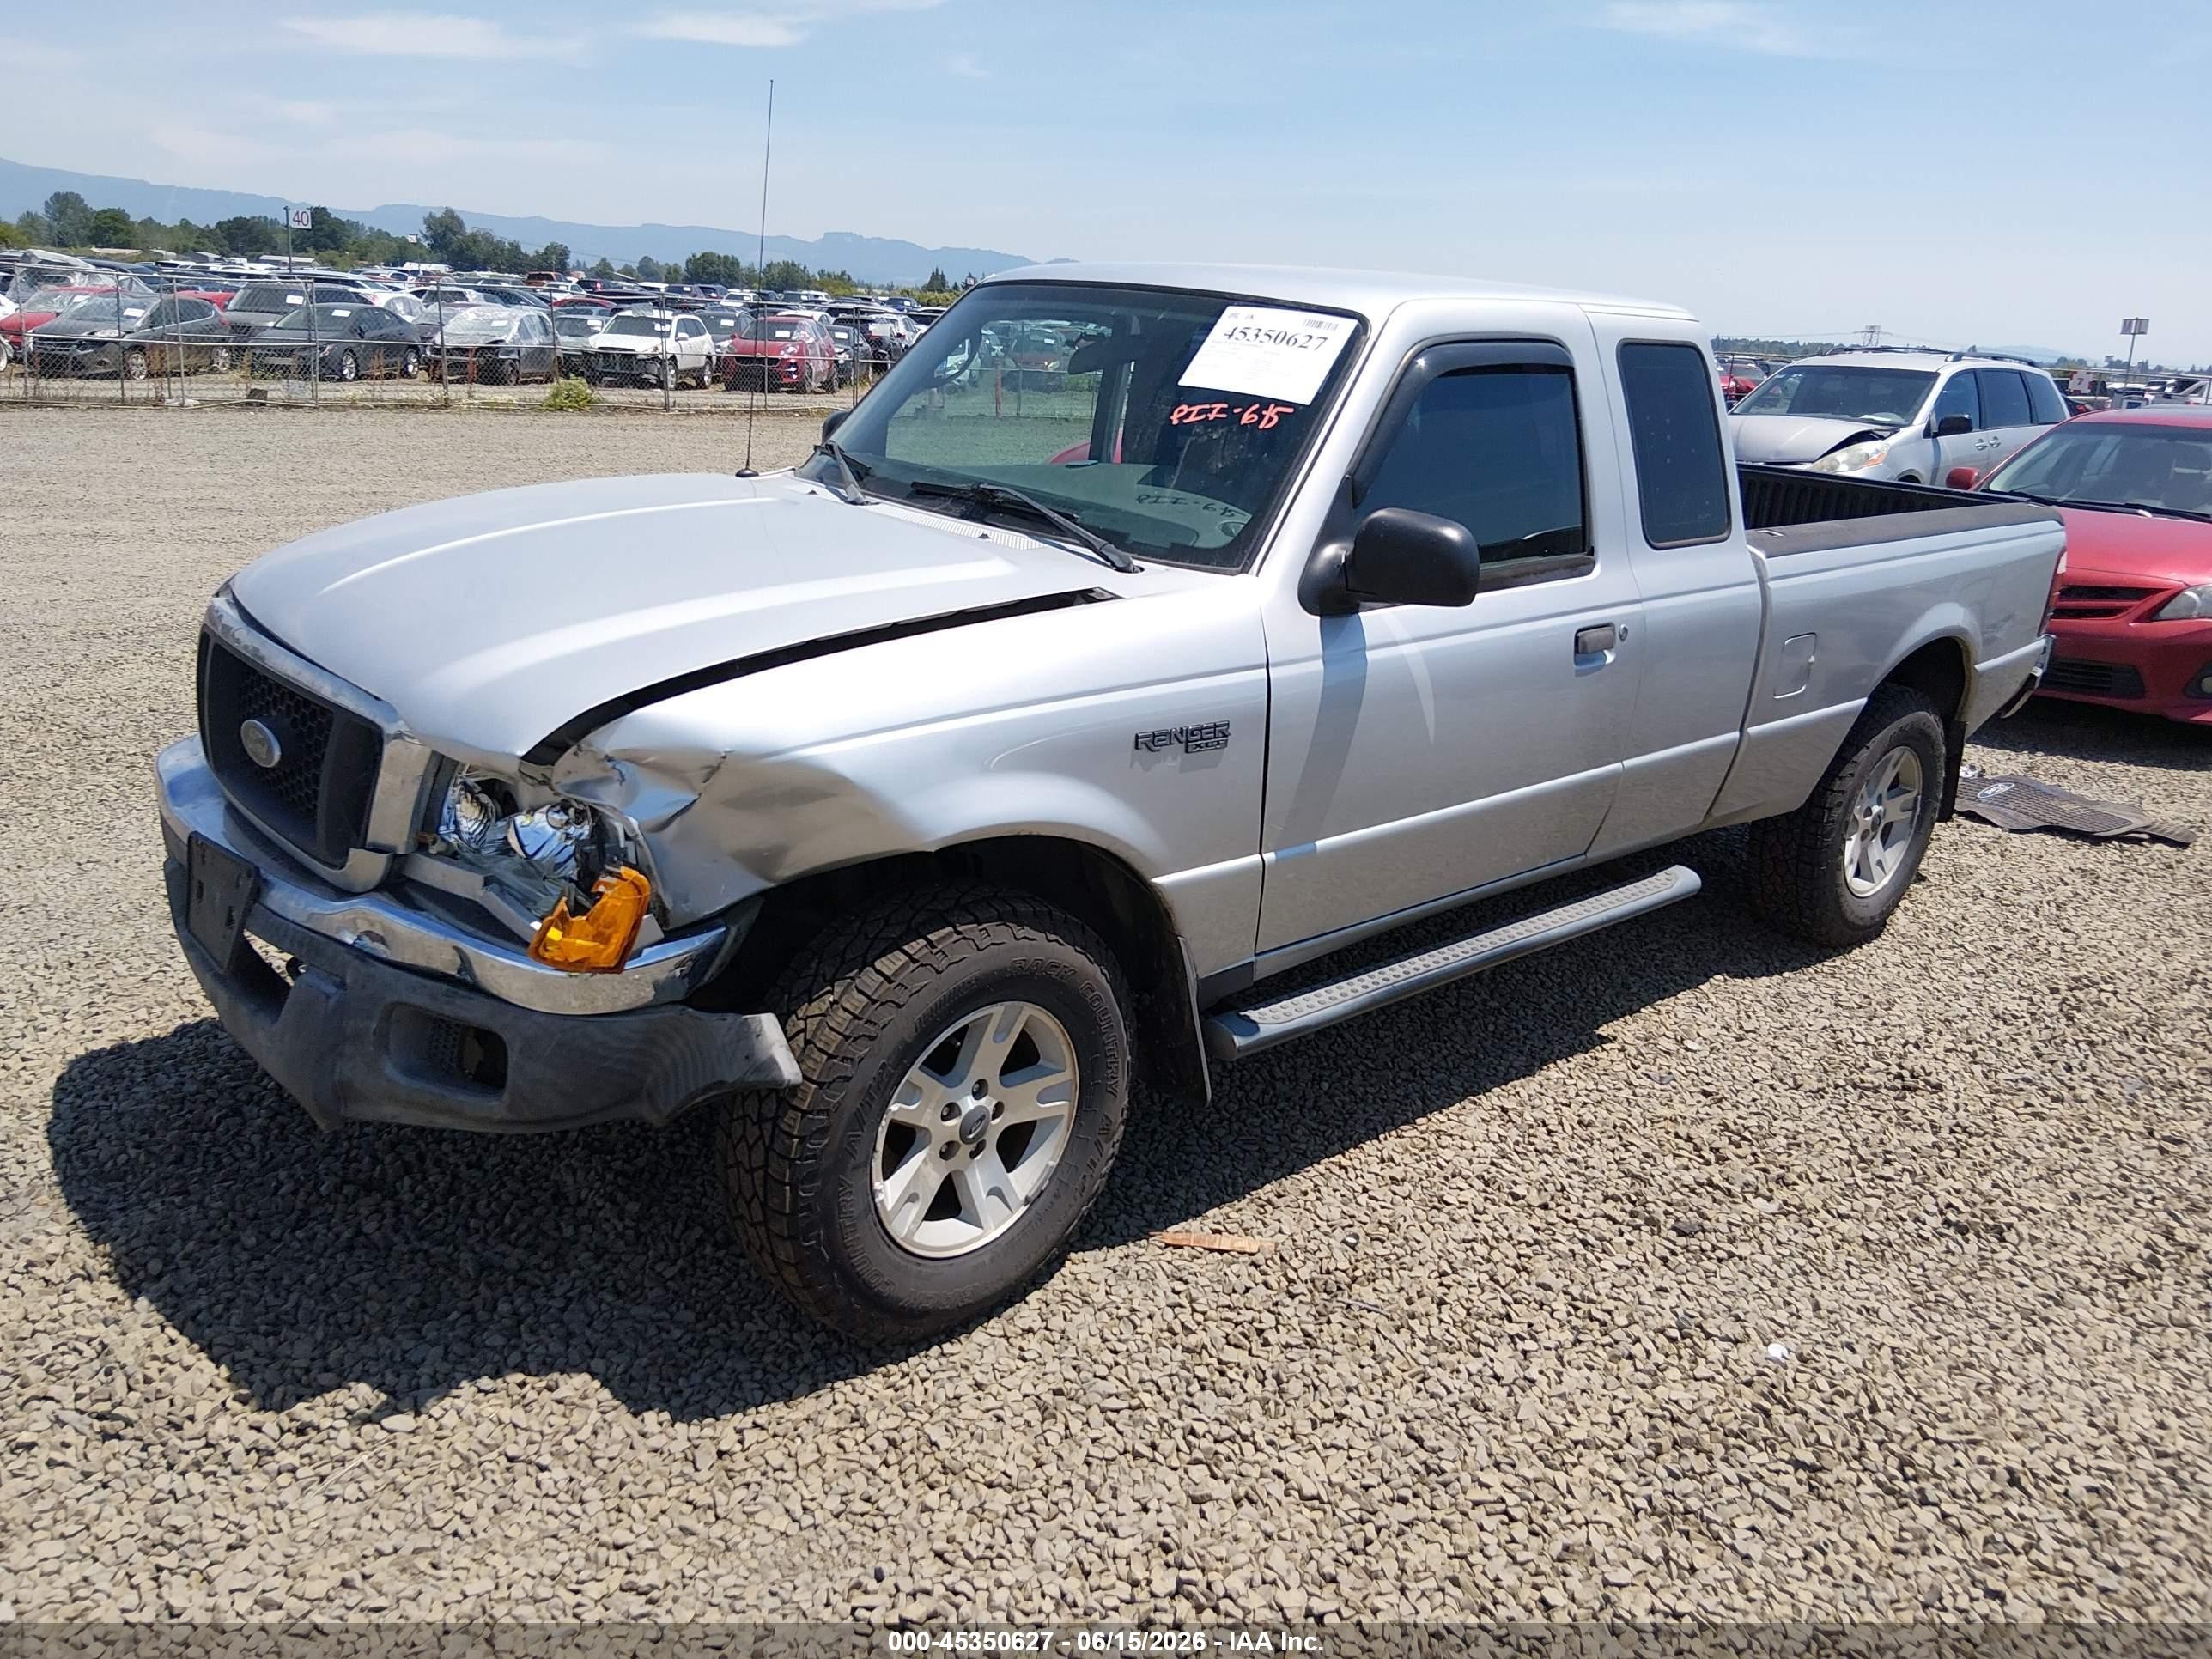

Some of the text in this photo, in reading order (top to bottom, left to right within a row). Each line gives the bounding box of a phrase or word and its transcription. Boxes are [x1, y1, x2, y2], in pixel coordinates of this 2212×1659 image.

[293, 210, 309, 226] 40
[1224, 326, 1328, 350] 45350627
[1135, 720, 1231, 752] RANGER
[1192, 739, 1227, 751] XLT
